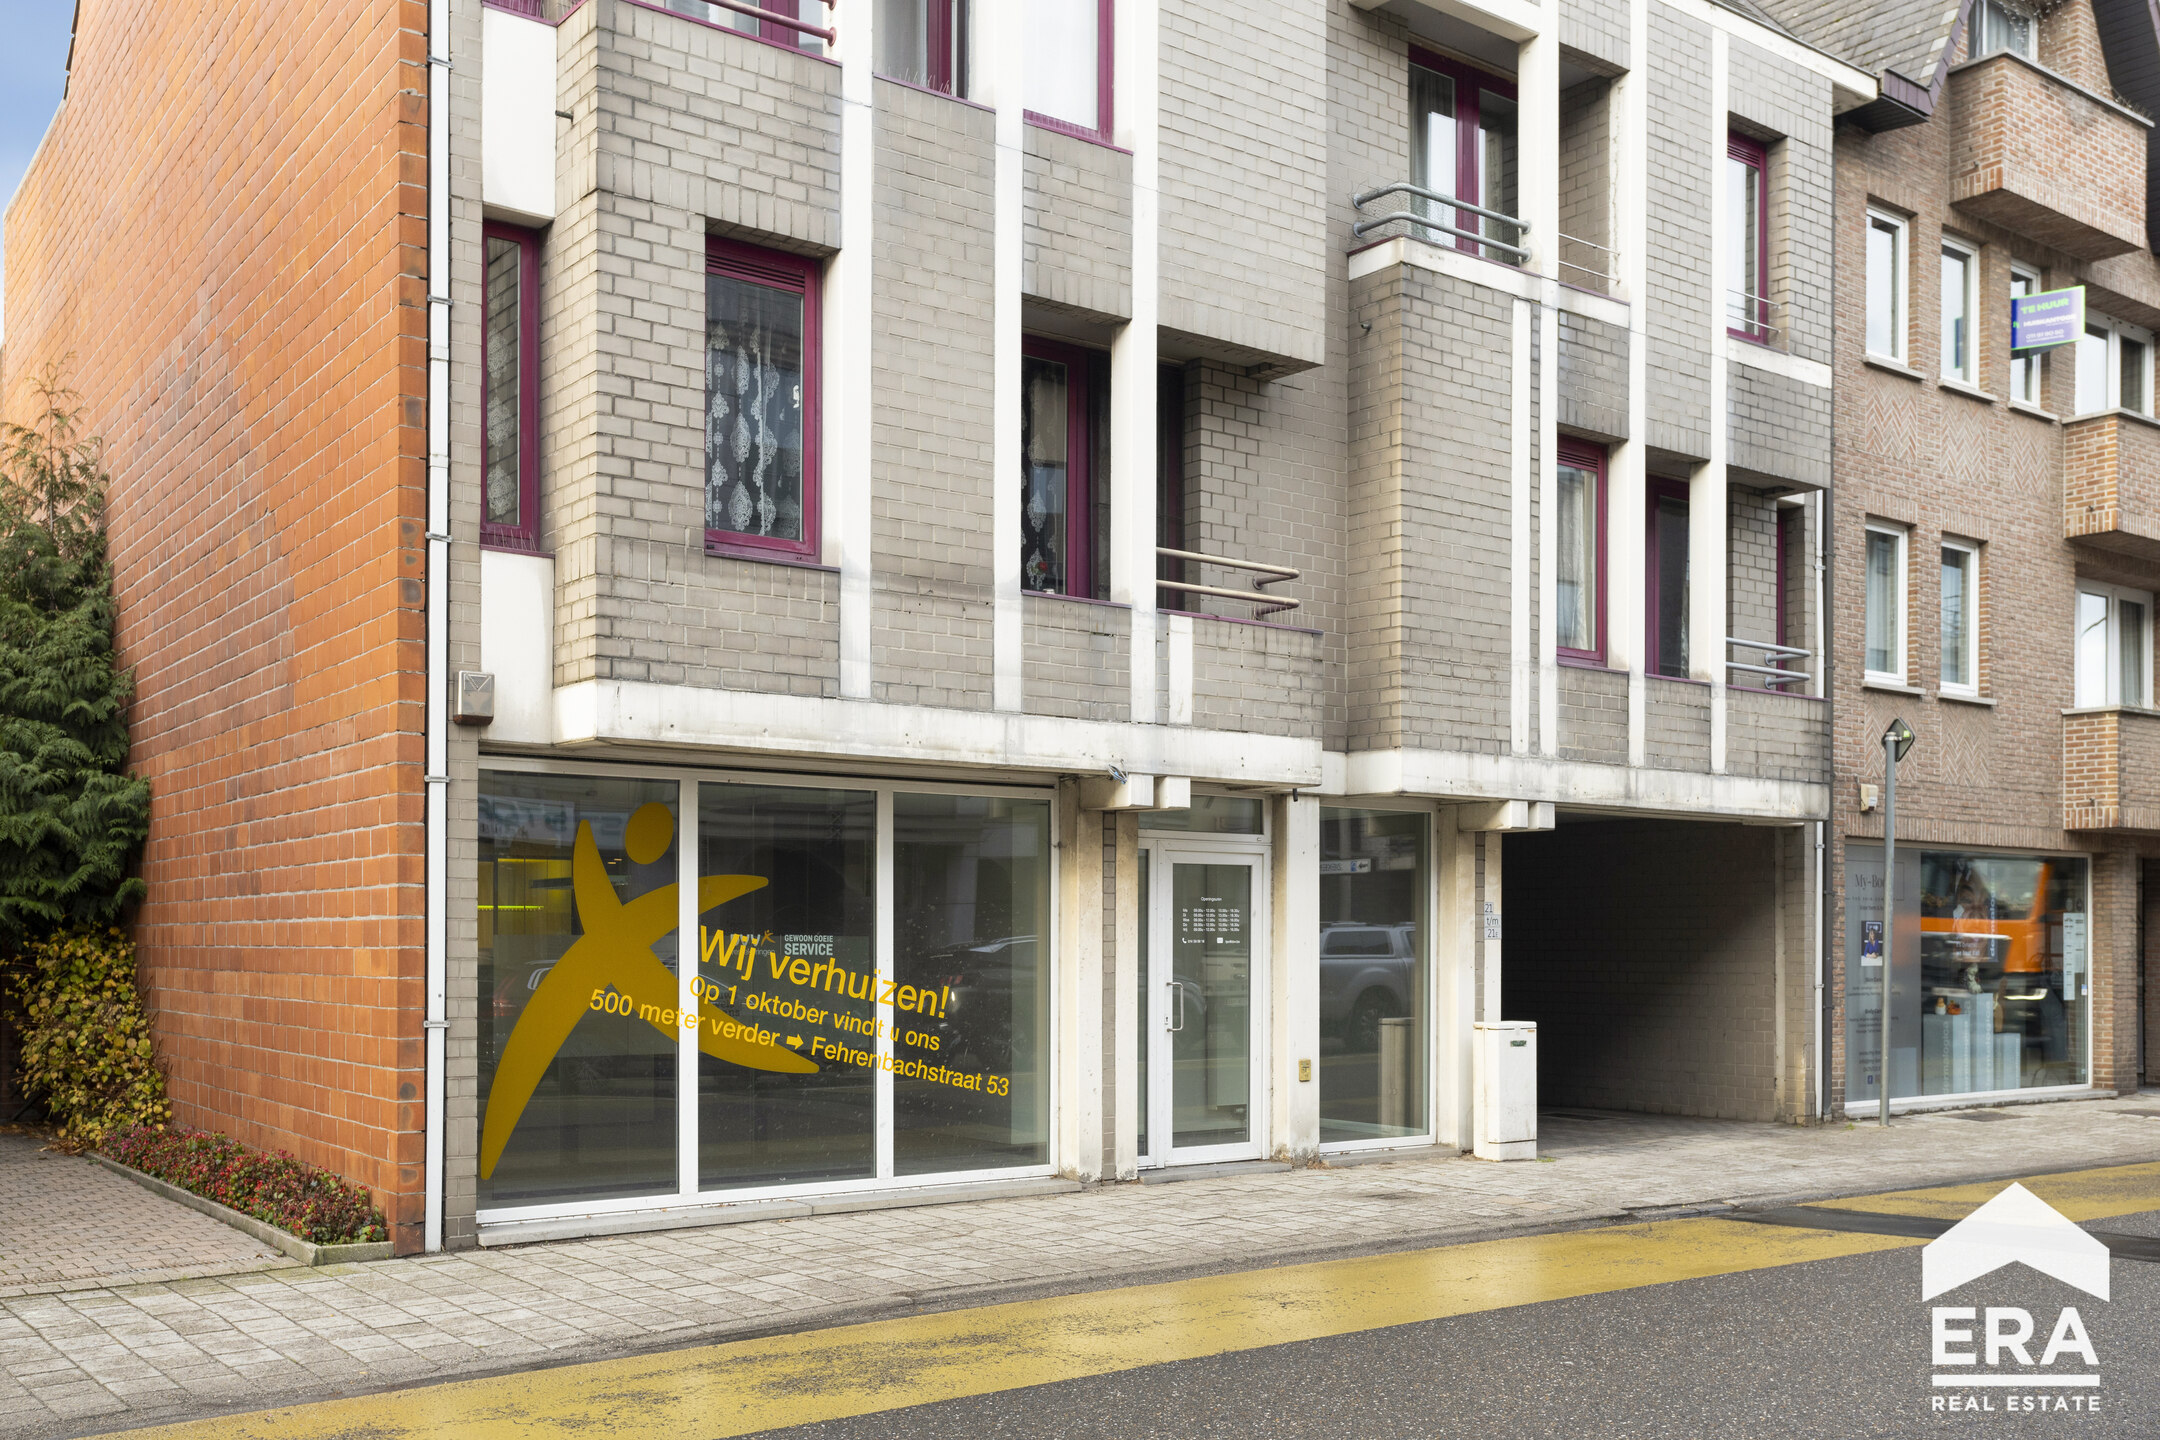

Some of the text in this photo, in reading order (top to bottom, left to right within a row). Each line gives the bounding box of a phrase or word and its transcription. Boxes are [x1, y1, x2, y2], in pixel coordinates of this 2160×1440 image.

[2021, 298, 2069, 314] TE HUUR
[1485, 903, 1493, 913] 21
[1487, 917, 1499, 926] t/m
[784, 943, 834, 956] SERVICE
[700, 925, 756, 981] Wij
[770, 951, 950, 1019] verhuizen!
[690, 976, 720, 1005] Op
[728, 985, 738, 1005] 1
[745, 991, 828, 1025] oktober
[833, 1011, 885, 1038] vindt
[889, 1027, 900, 1042] u
[905, 1030, 941, 1051] ons
[589, 989, 633, 1016] 500
[639, 1003, 706, 1030] meter
[711, 1018, 781, 1047] verder
[811, 1036, 983, 1091] Fehrenbachstraat
[986, 1075, 1010, 1096] 53
